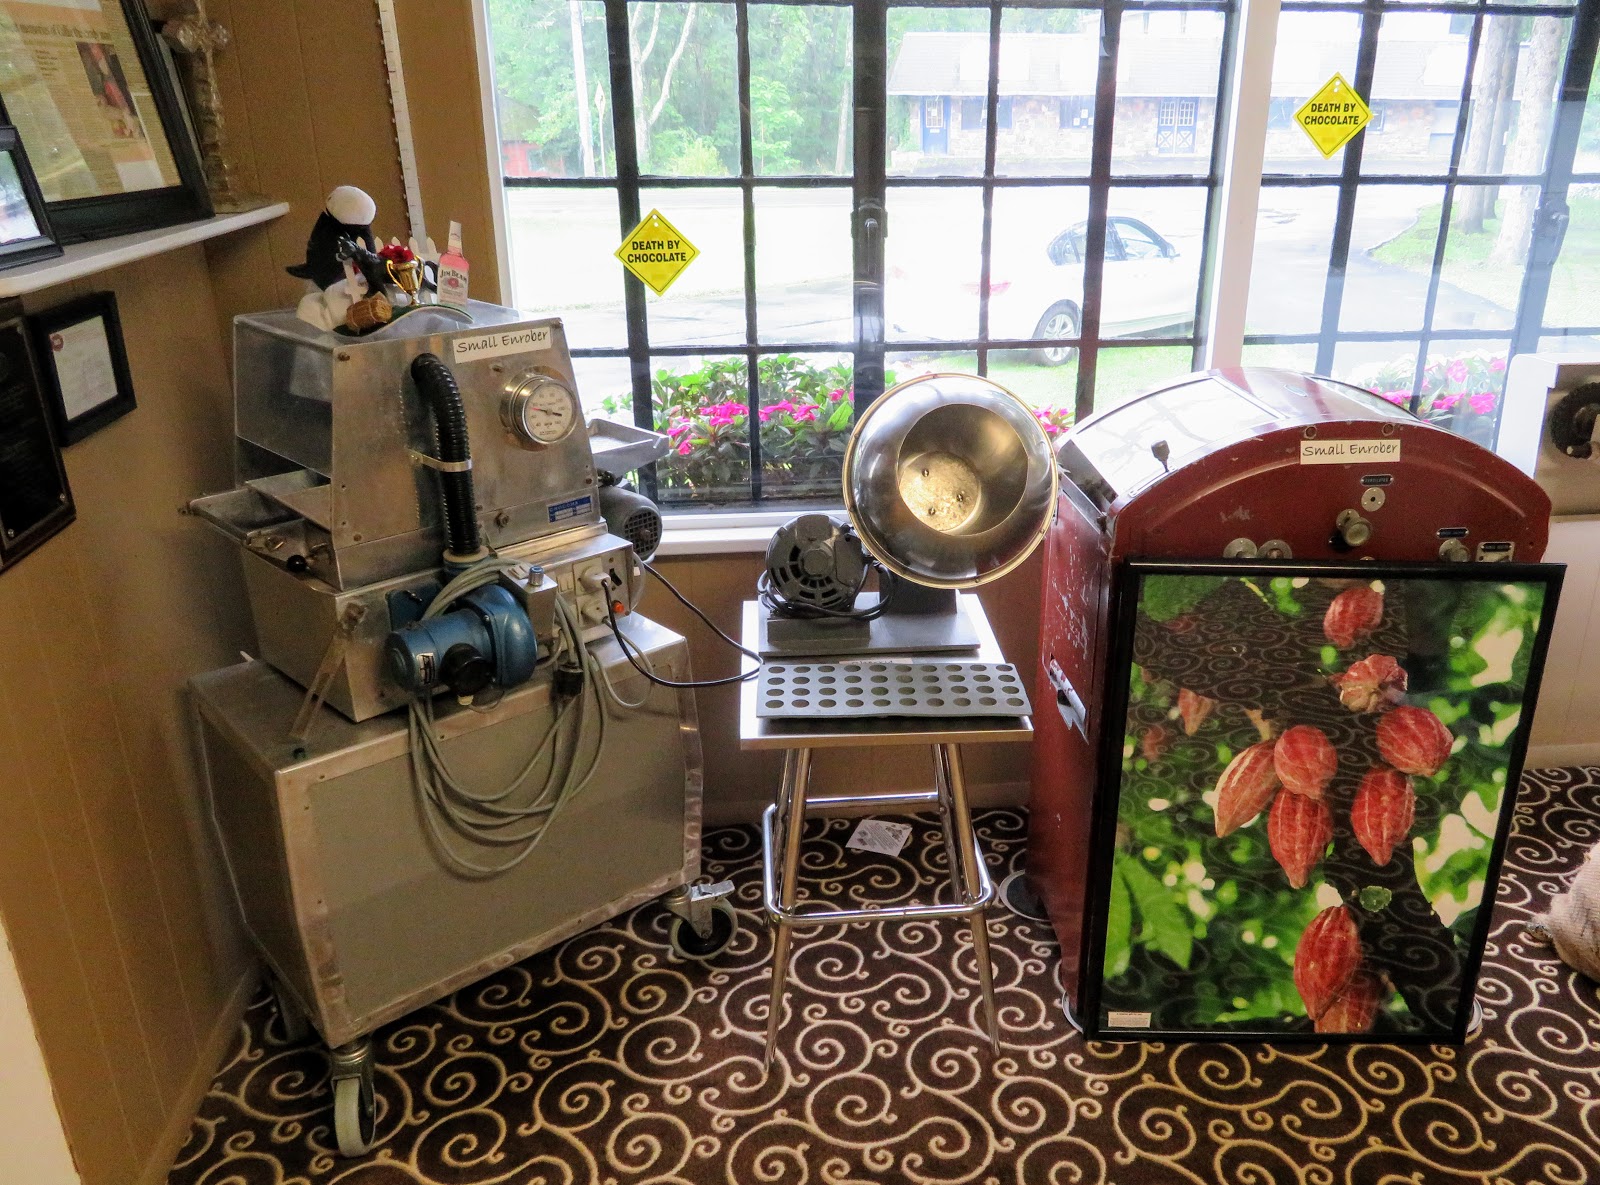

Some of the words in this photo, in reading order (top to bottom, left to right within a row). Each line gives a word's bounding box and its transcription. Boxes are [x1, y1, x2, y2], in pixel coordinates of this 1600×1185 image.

[1311, 103, 1341, 113] DEATH
[1343, 103, 1357, 112] BY
[1304, 115, 1359, 125] CHOCOLATE
[632, 241, 664, 250] DEATH
[667, 240, 680, 250] BY
[627, 252, 686, 263] CHOCOLATE
[440, 269, 451, 279] JIM
[456, 336, 498, 353] Small
[502, 329, 548, 346] Enrober
[1302, 443, 1345, 457] Small
[1349, 441, 1398, 455] Enrober
